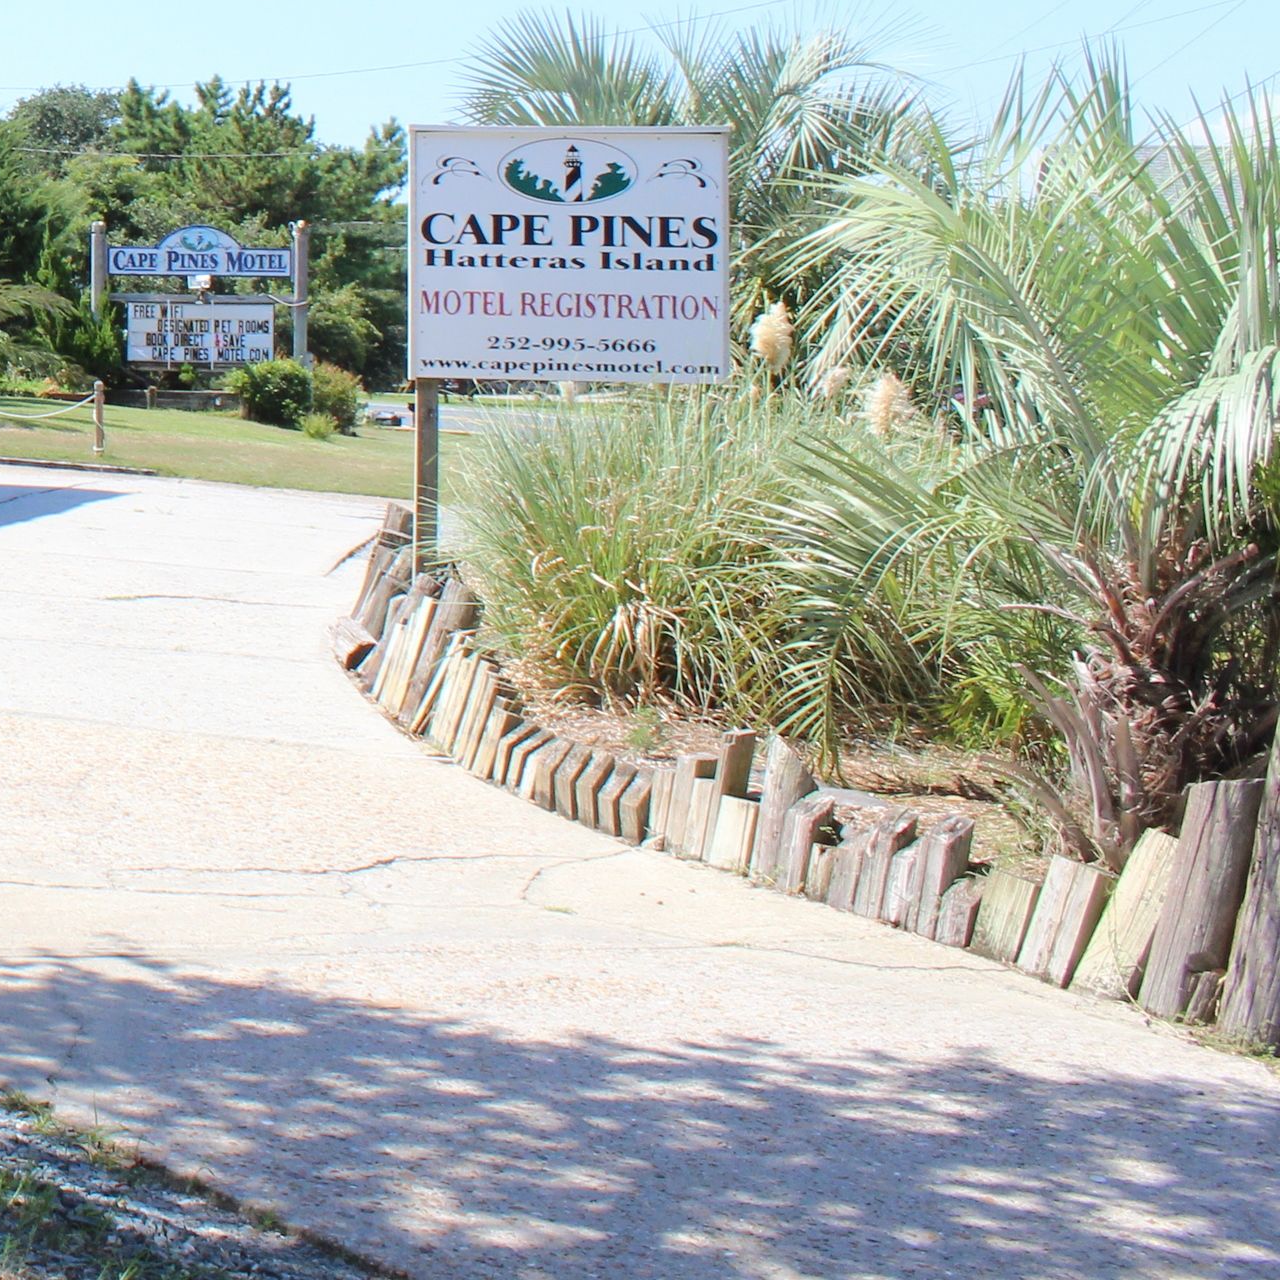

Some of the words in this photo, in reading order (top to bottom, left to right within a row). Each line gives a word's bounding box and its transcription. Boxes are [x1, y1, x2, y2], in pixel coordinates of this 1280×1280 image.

[421, 213, 553, 246] CAPE
[569, 215, 719, 249] PINES
[423, 249, 586, 270] Hatteras
[600, 252, 715, 271] Island
[133, 305, 155, 319] FREE
[420, 290, 512, 317] MOTEL
[520, 292, 719, 320] REGISTRATION
[157, 320, 209, 333] DESIGNATED
[214, 320, 231, 333] PET
[238, 320, 269, 334] ROOMS
[146, 333, 168, 346] BOOK
[173, 333, 204, 347] DIRECT
[223, 334, 245, 347] SAVE
[487, 336, 656, 353] 252-995-5666
[151, 347, 175, 360] CAPE
[183, 348, 209, 360] PINES
[421, 358, 720, 375] www.capepinesmotel.com
